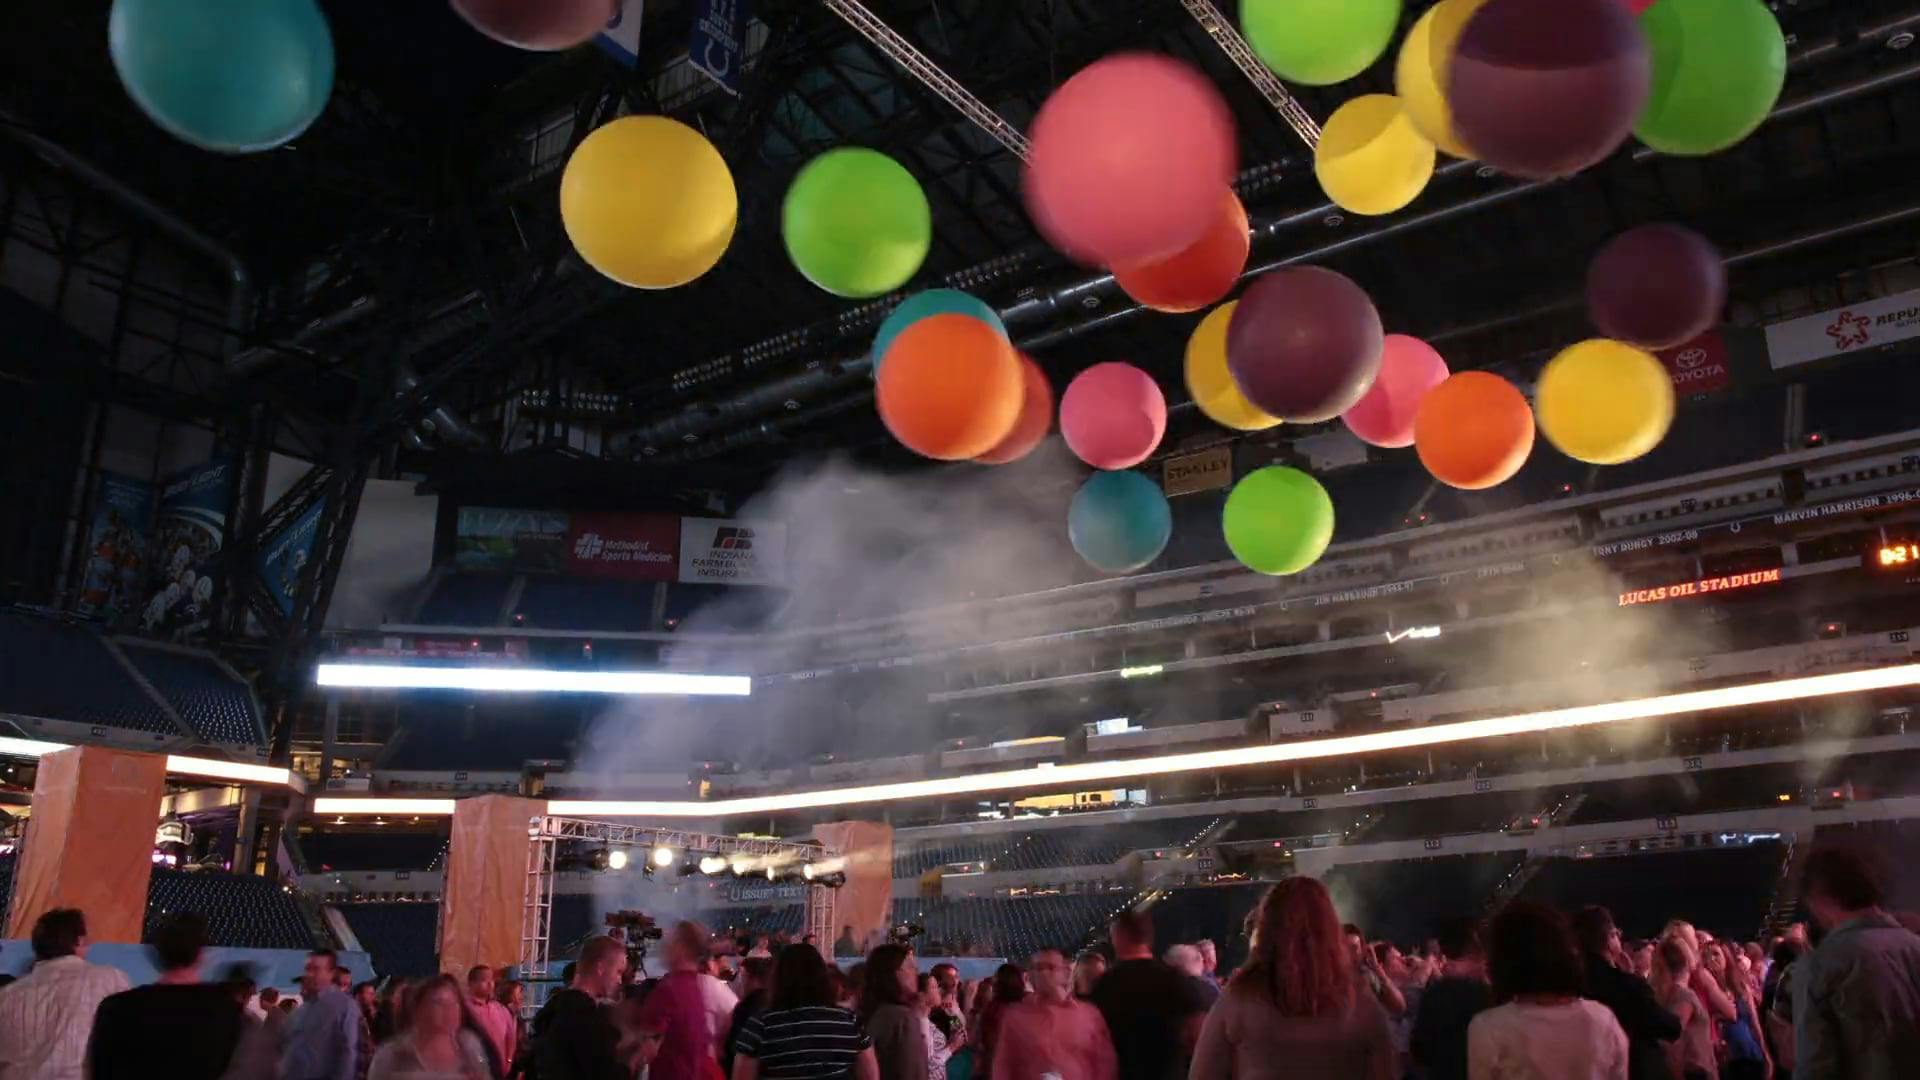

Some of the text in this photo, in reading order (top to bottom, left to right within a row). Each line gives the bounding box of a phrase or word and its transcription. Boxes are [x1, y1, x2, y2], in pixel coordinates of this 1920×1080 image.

[1672, 364, 1725, 384] OYOTA
[1773, 508, 1819, 525] MARVIN
[1821, 496, 1880, 516] HARRISON
[605, 540, 650, 551] Methodist
[1593, 543, 1618, 557] TONY
[1620, 538, 1654, 553] DUNGY
[601, 551, 673, 563] Sports Medicine
[1618, 568, 1779, 606] LUCAS OIL STADIUM
